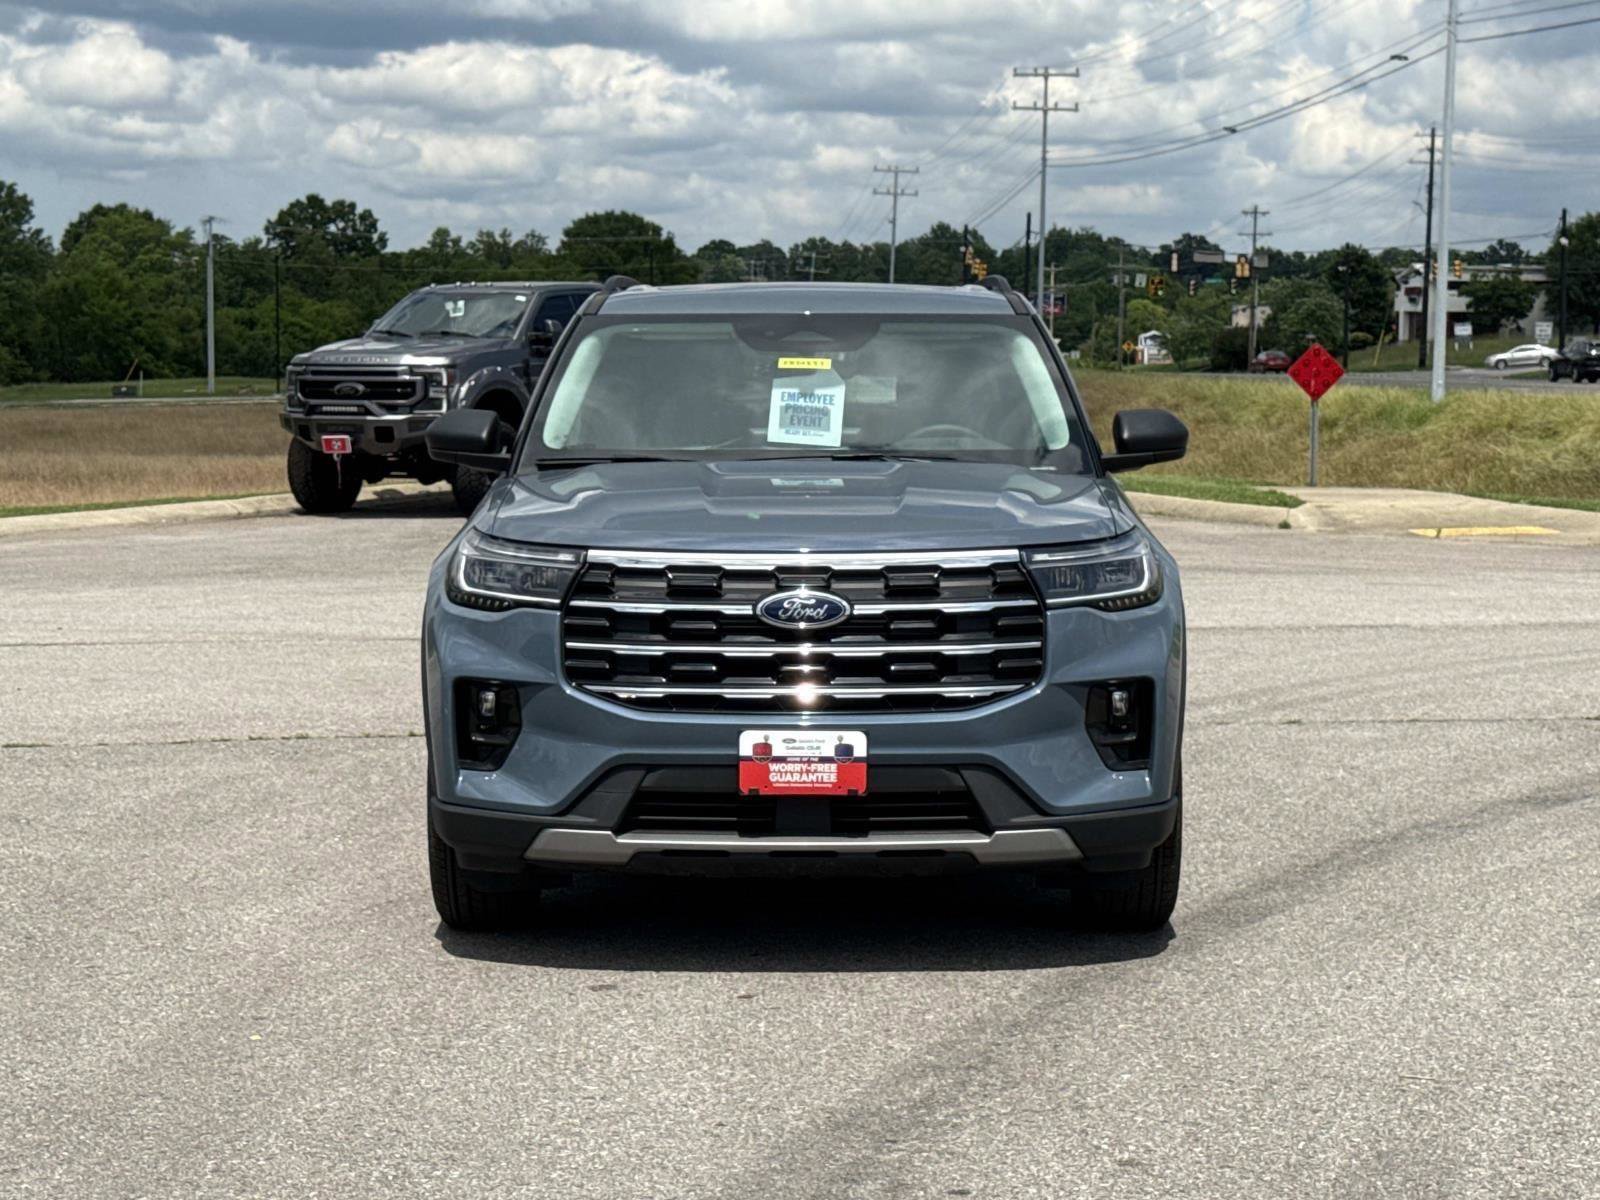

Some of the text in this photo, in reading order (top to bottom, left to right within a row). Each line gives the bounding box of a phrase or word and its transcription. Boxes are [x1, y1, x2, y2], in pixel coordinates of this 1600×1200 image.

[781, 391, 835, 406] EMPLOYEE
[785, 403, 829, 417] PRICING
[790, 415, 823, 428] EVENT
[778, 598, 828, 619] Ford
[768, 763, 838, 773] WORRY-FREE
[769, 773, 838, 783] GUARANTEE
